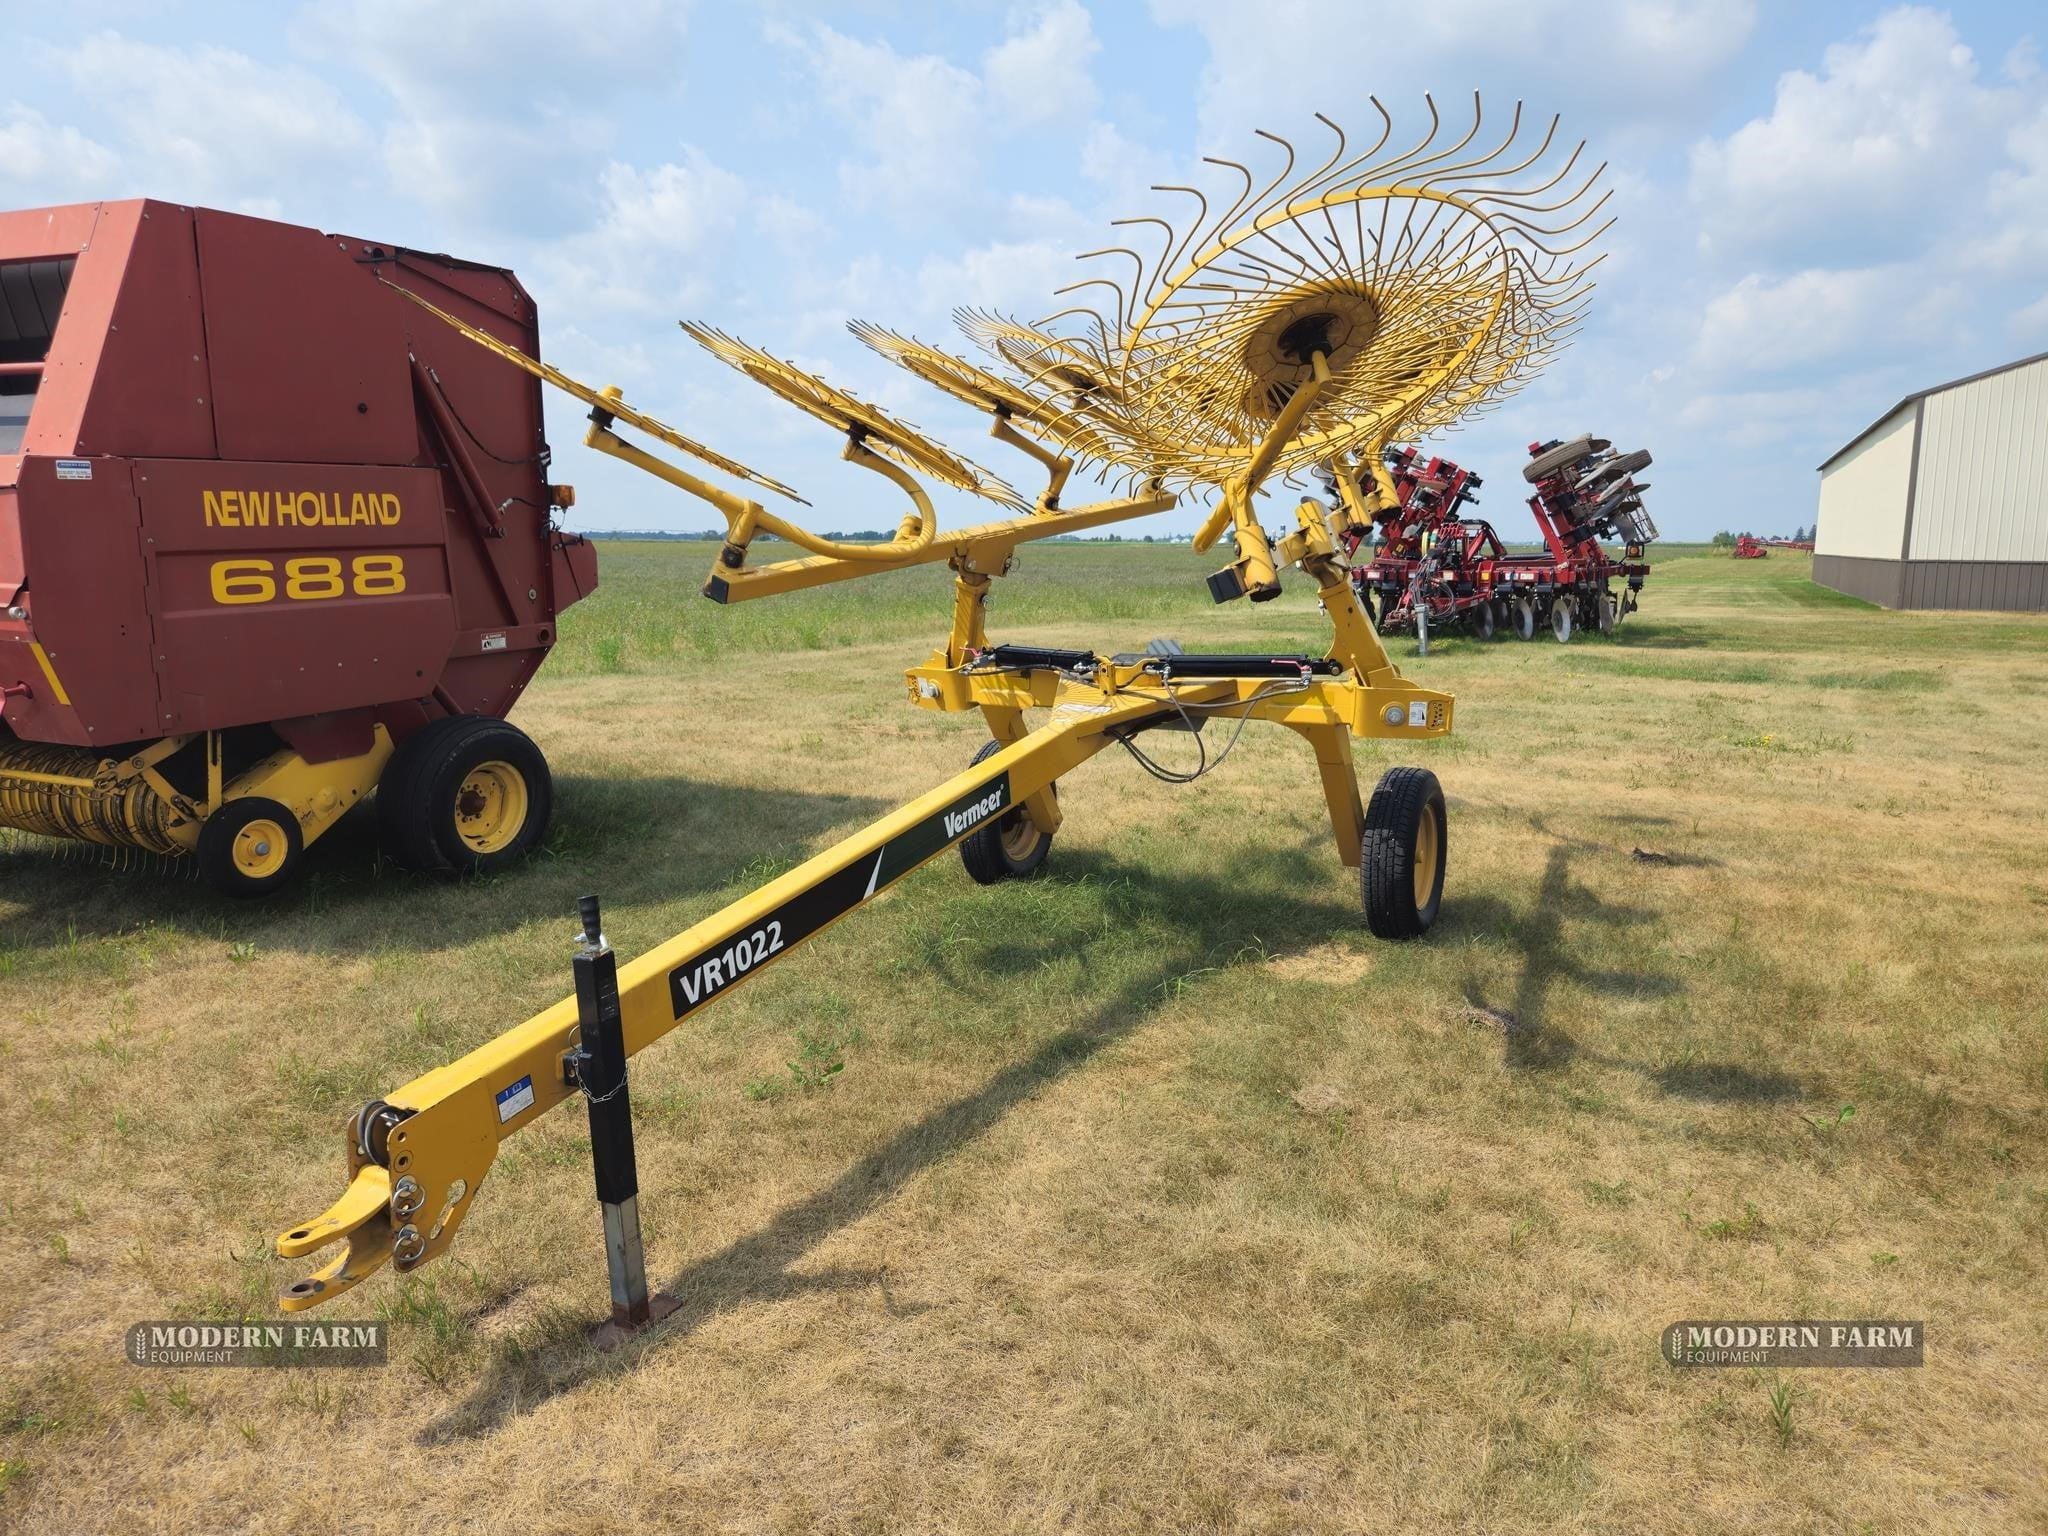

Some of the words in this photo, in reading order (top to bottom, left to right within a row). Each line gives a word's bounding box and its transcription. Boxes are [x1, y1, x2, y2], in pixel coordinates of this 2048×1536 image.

[203, 490, 270, 527] NEW
[275, 491, 401, 527] HOLLAND
[210, 554, 407, 605] 688
[943, 789, 1002, 839] Vermeer
[679, 920, 784, 1005] VR1022
